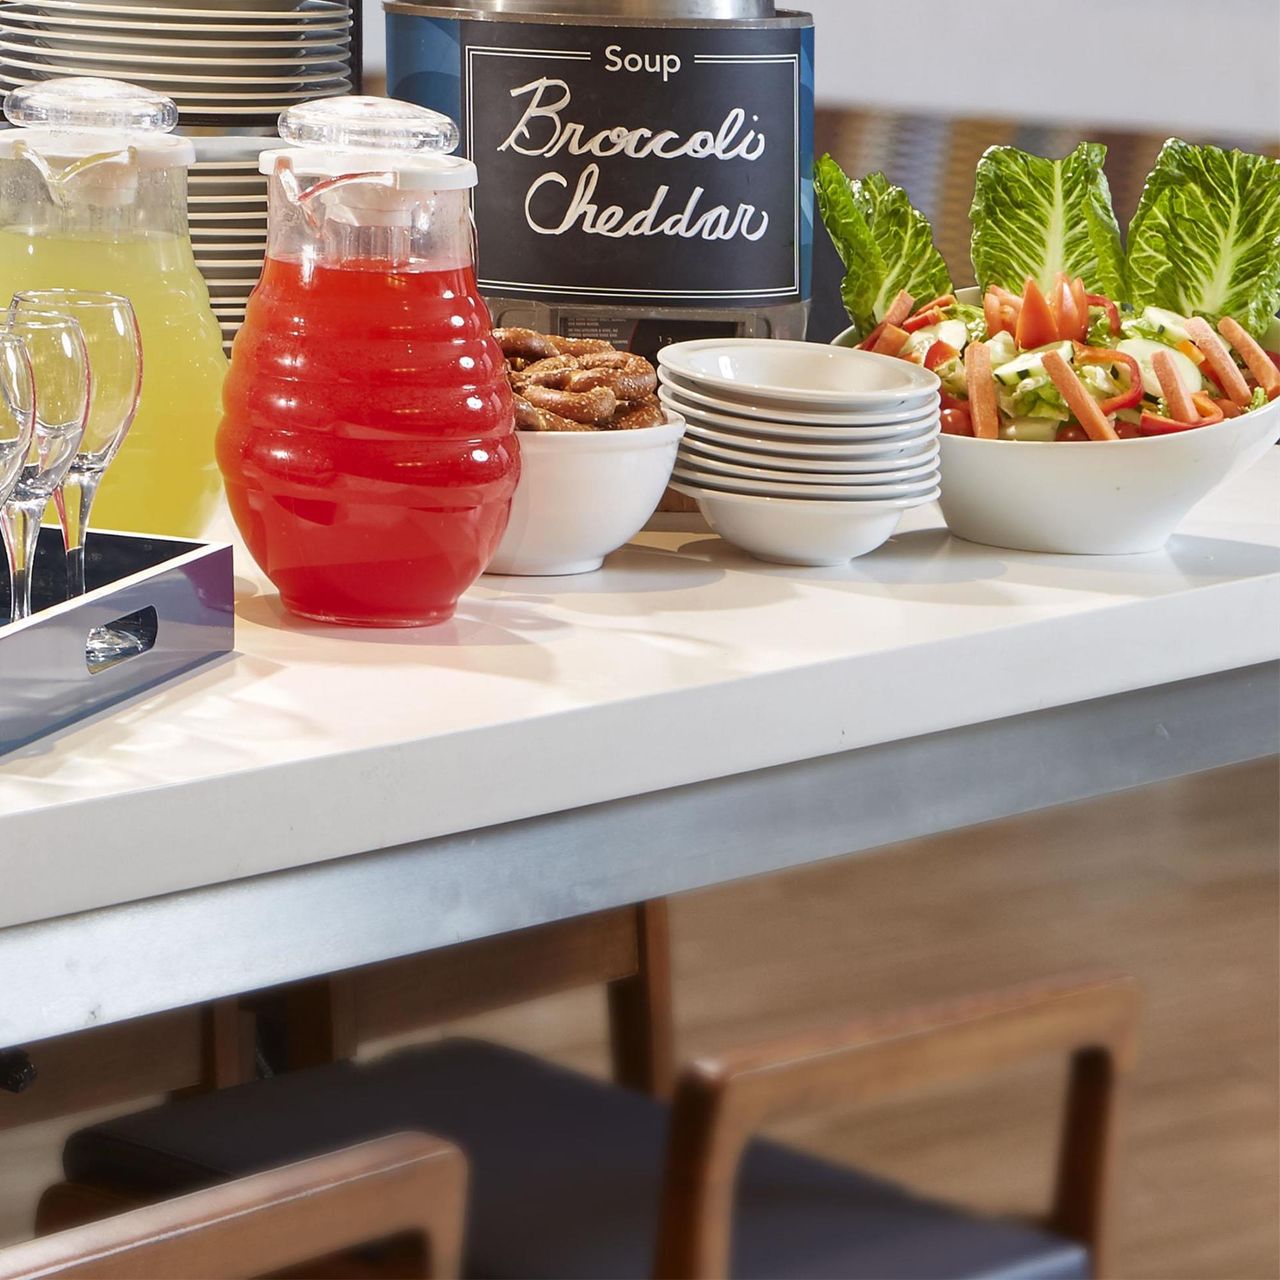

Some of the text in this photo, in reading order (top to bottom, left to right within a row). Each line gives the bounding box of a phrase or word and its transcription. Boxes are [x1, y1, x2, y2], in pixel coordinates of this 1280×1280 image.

[604, 45, 681, 81] Soup
[497, 76, 765, 160] Broccoli
[524, 162, 770, 242] Cheddar
